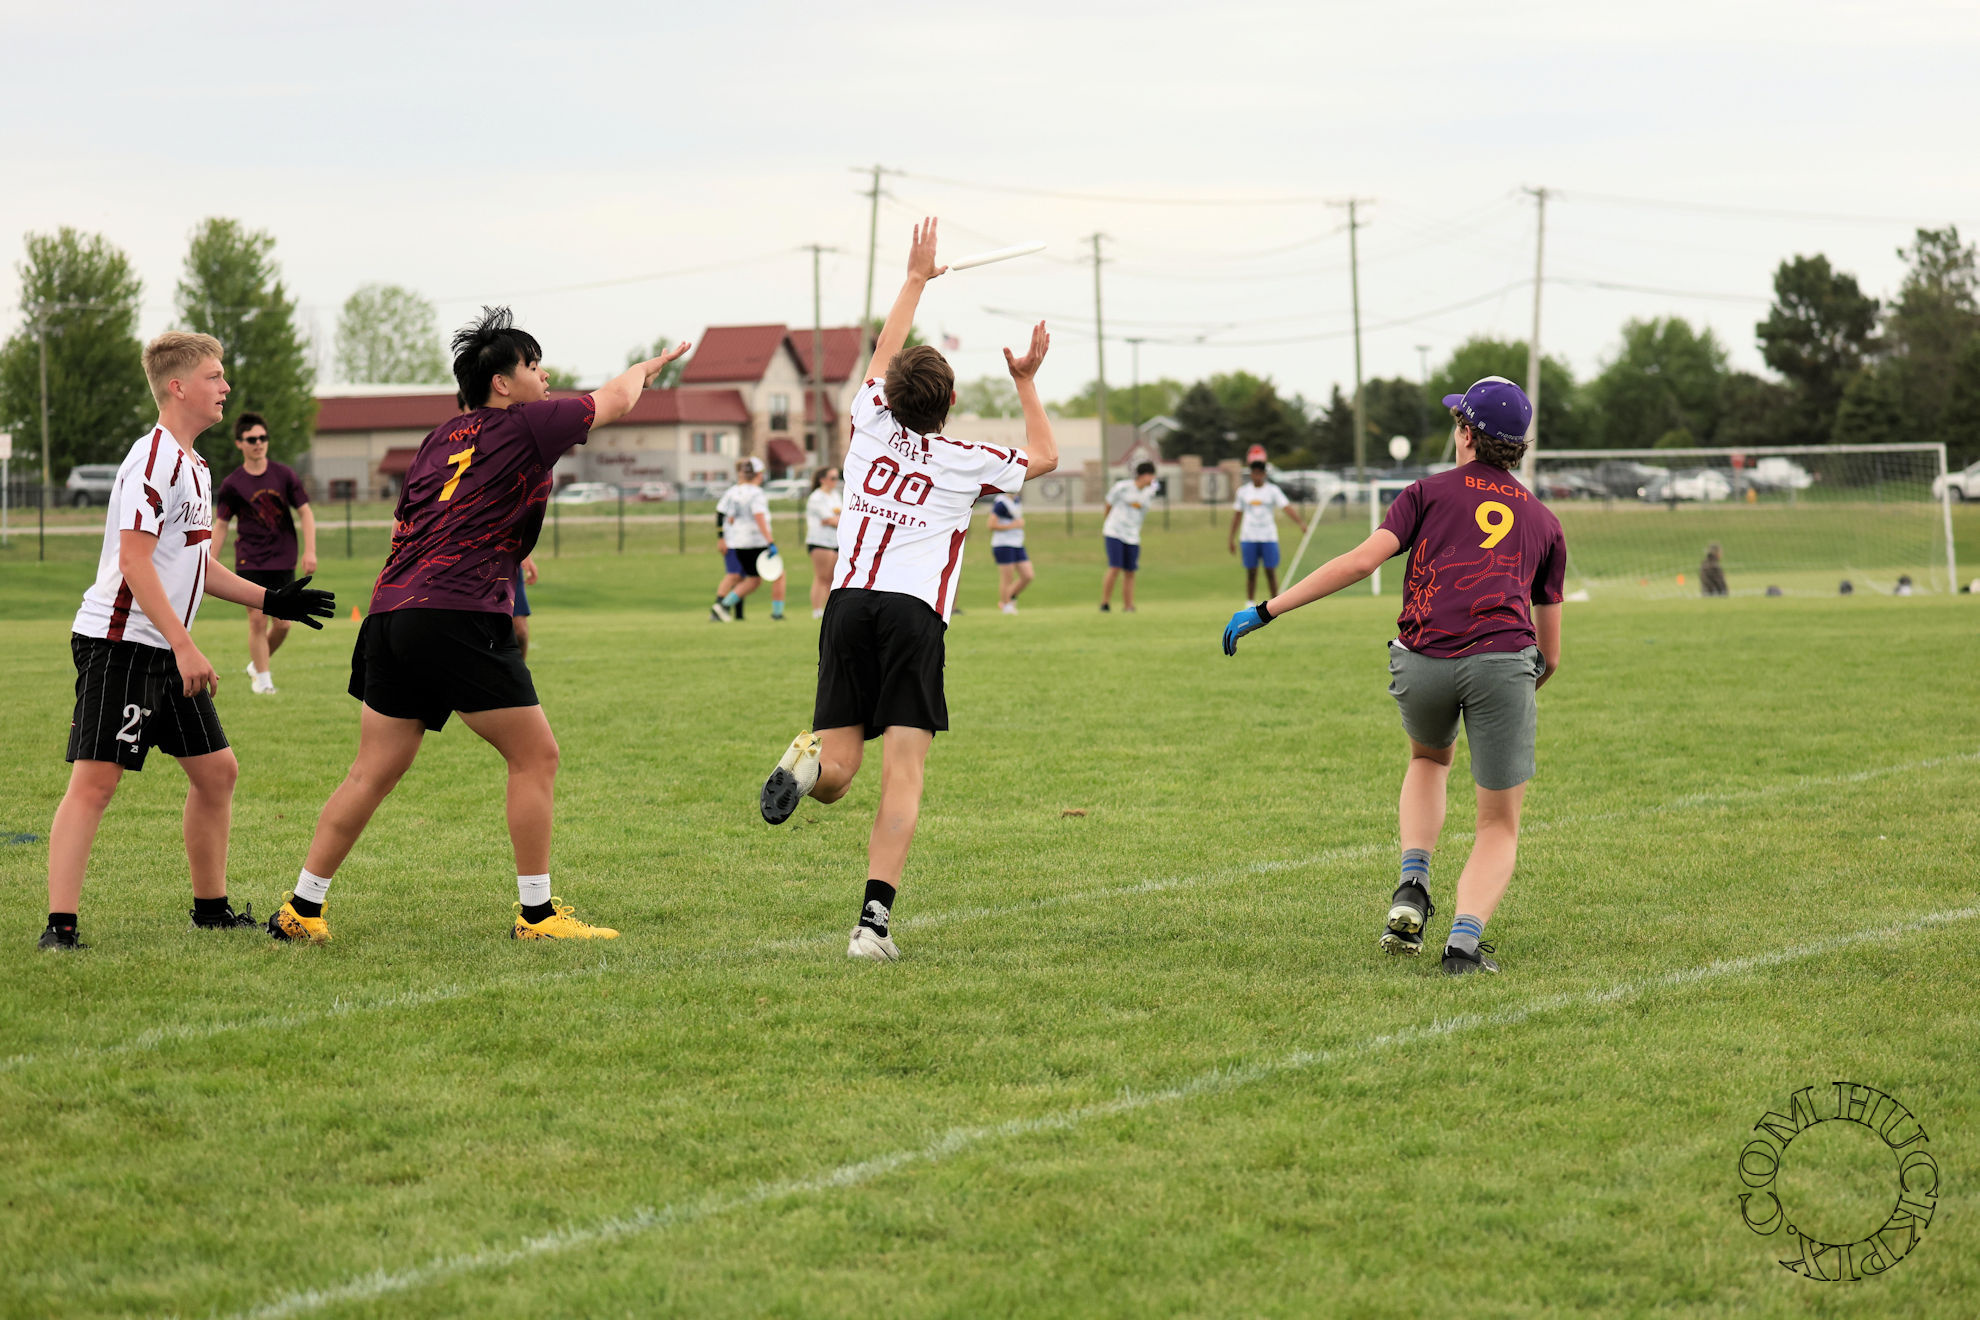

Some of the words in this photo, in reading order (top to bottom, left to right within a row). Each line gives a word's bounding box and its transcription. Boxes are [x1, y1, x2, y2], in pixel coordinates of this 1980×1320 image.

[863, 456, 934, 506] 00
[1465, 475, 1528, 502] BEACH
[1475, 501, 1514, 549] 9
[116, 704, 152, 743] 2
